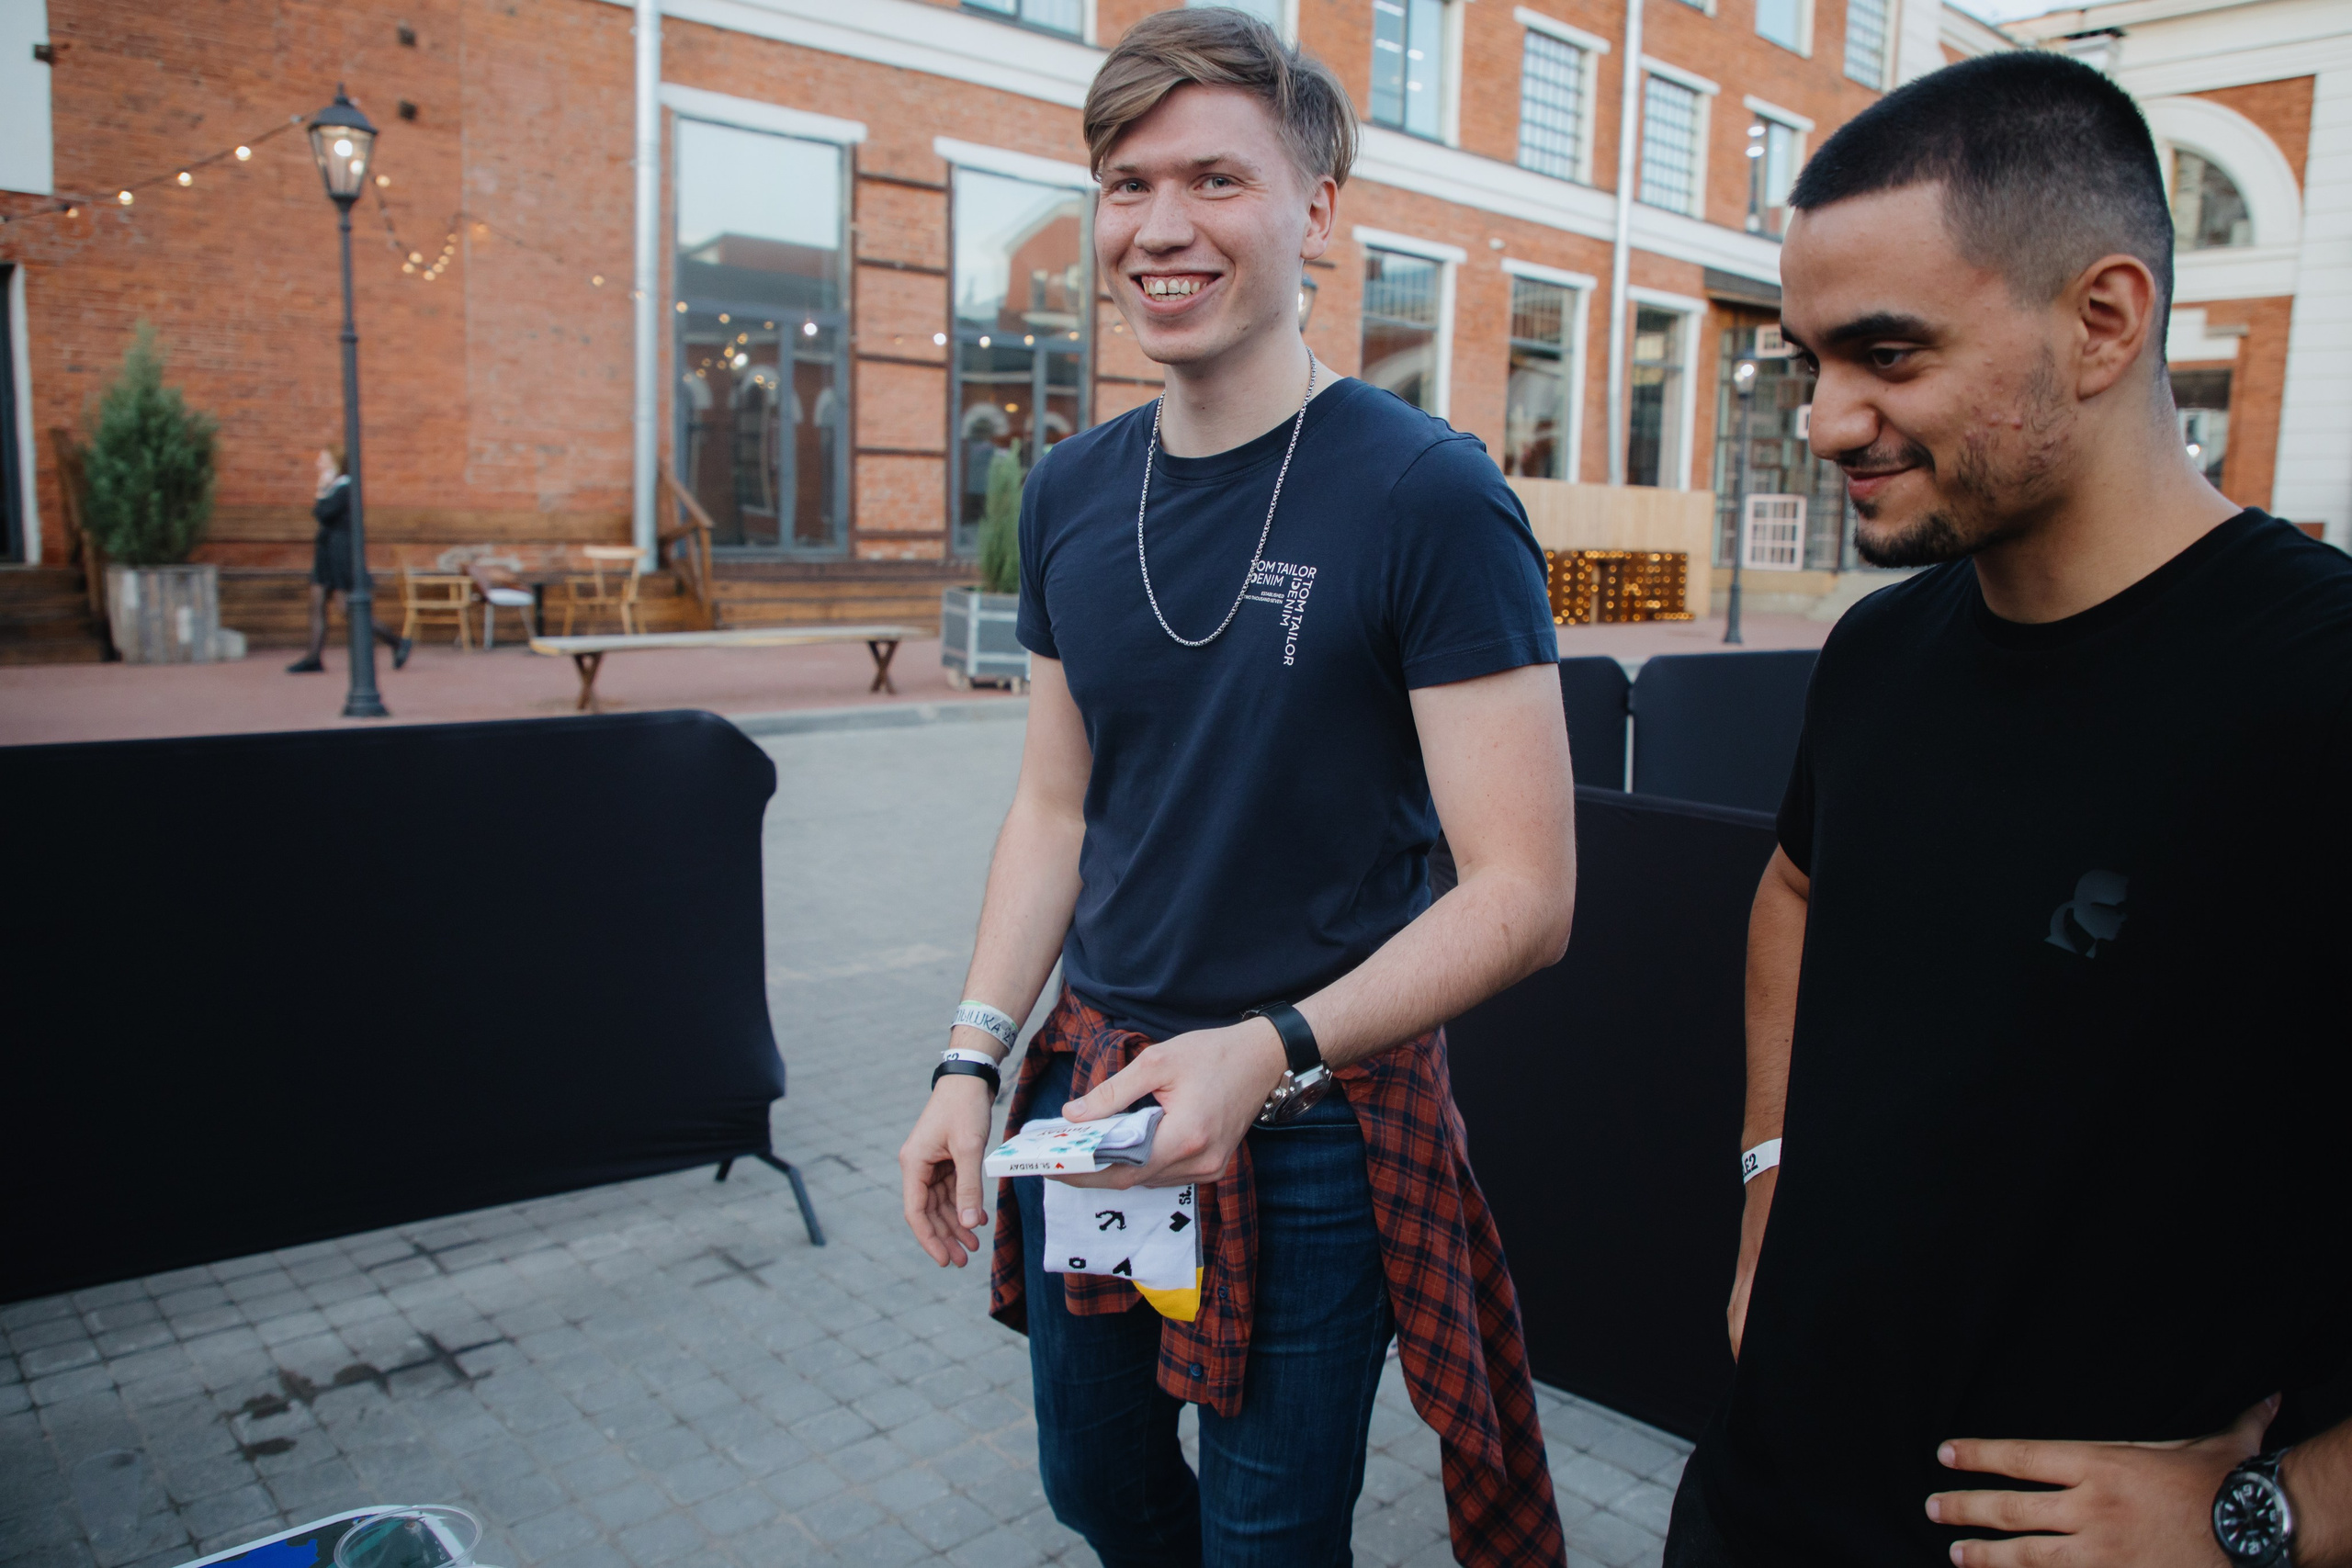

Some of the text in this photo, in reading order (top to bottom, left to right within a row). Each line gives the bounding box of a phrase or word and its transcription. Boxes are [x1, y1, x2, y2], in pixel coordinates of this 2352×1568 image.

[1251, 559, 1317, 579] OM TAILOR
[1261, 591, 1285, 599] ESTABLISHED
[1280, 578, 1302, 626] DENIM
[1283, 581, 1313, 666] TOM TAILOR
[1009, 1162, 1038, 1171] FRIDAY
